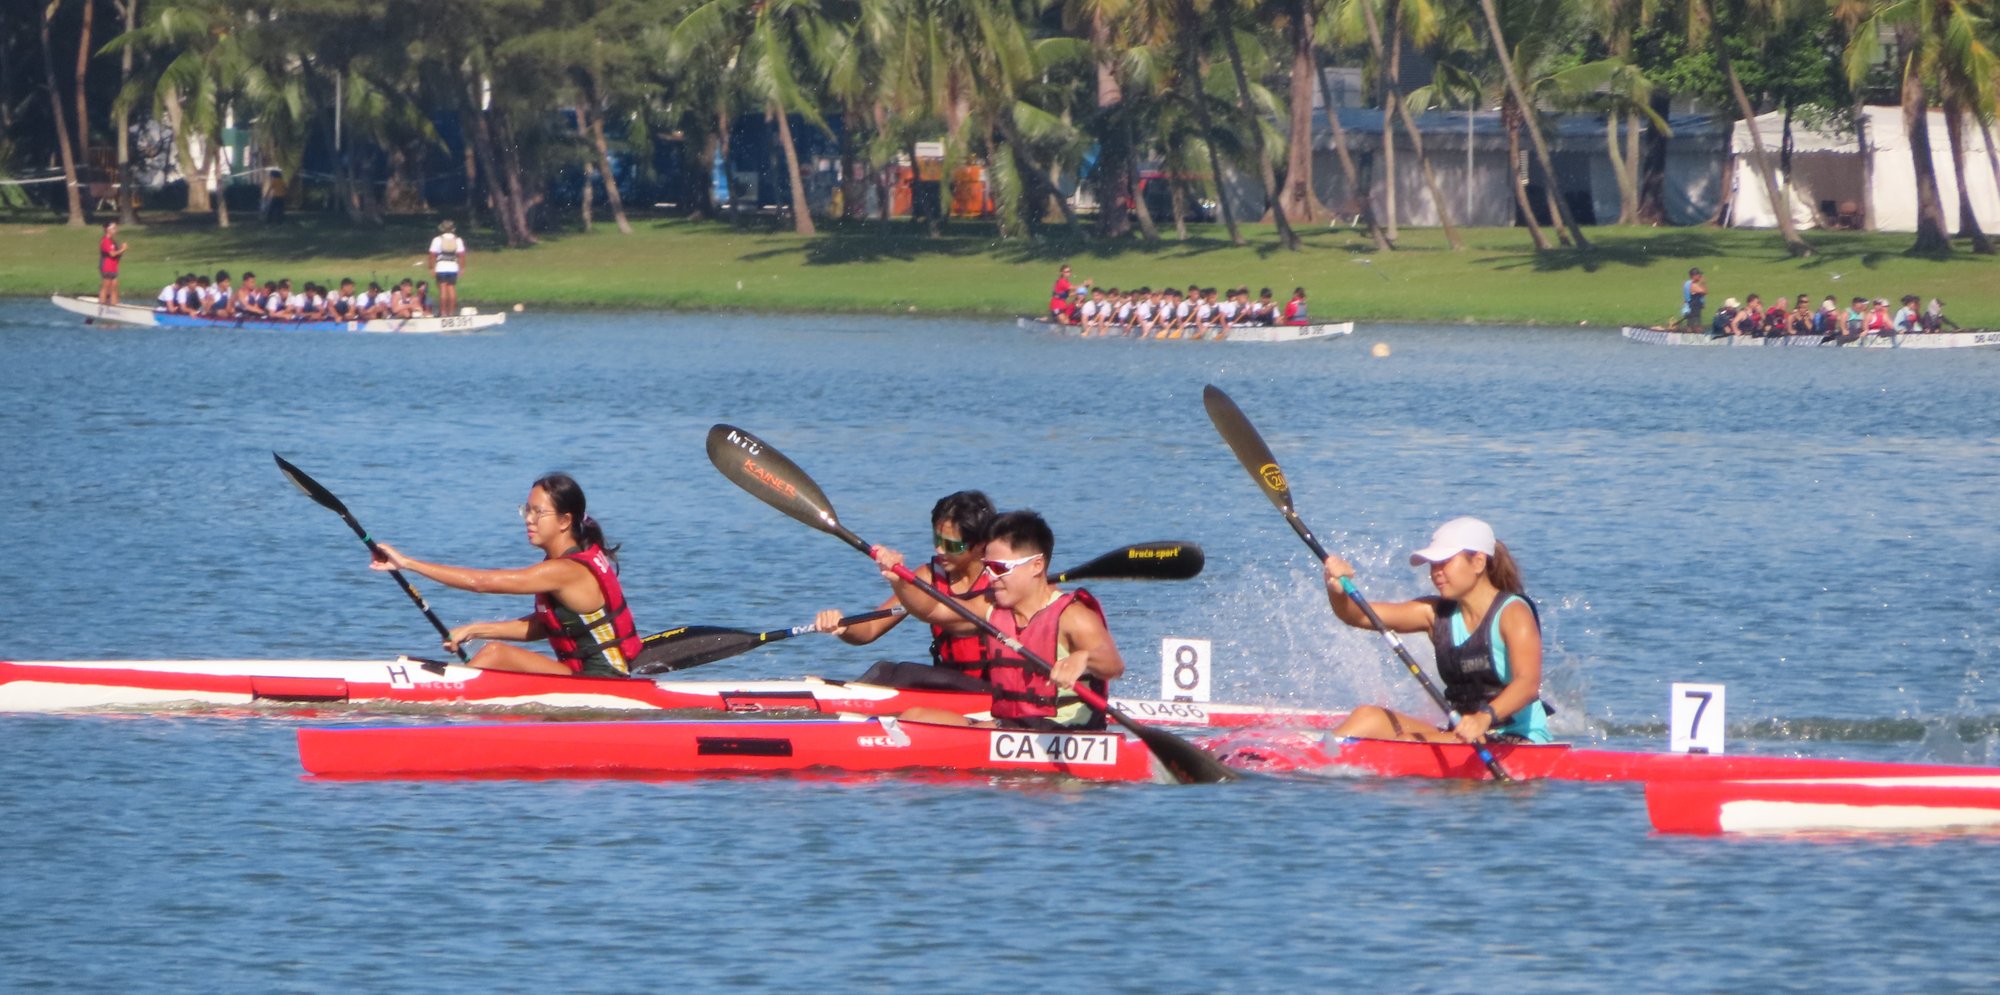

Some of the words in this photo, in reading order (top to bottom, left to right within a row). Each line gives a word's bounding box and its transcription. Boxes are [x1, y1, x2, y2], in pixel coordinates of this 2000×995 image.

[441, 318, 455, 328] DB
[727, 430, 763, 455] NTU
[744, 459, 796, 498] KAINER
[387, 665, 410, 684] H
[1174, 645, 1199, 690] 8
[1139, 702, 1205, 718] 0466
[1685, 690, 1713, 740] 7
[995, 734, 1035, 759] CA
[1046, 736, 1109, 761] 4071
